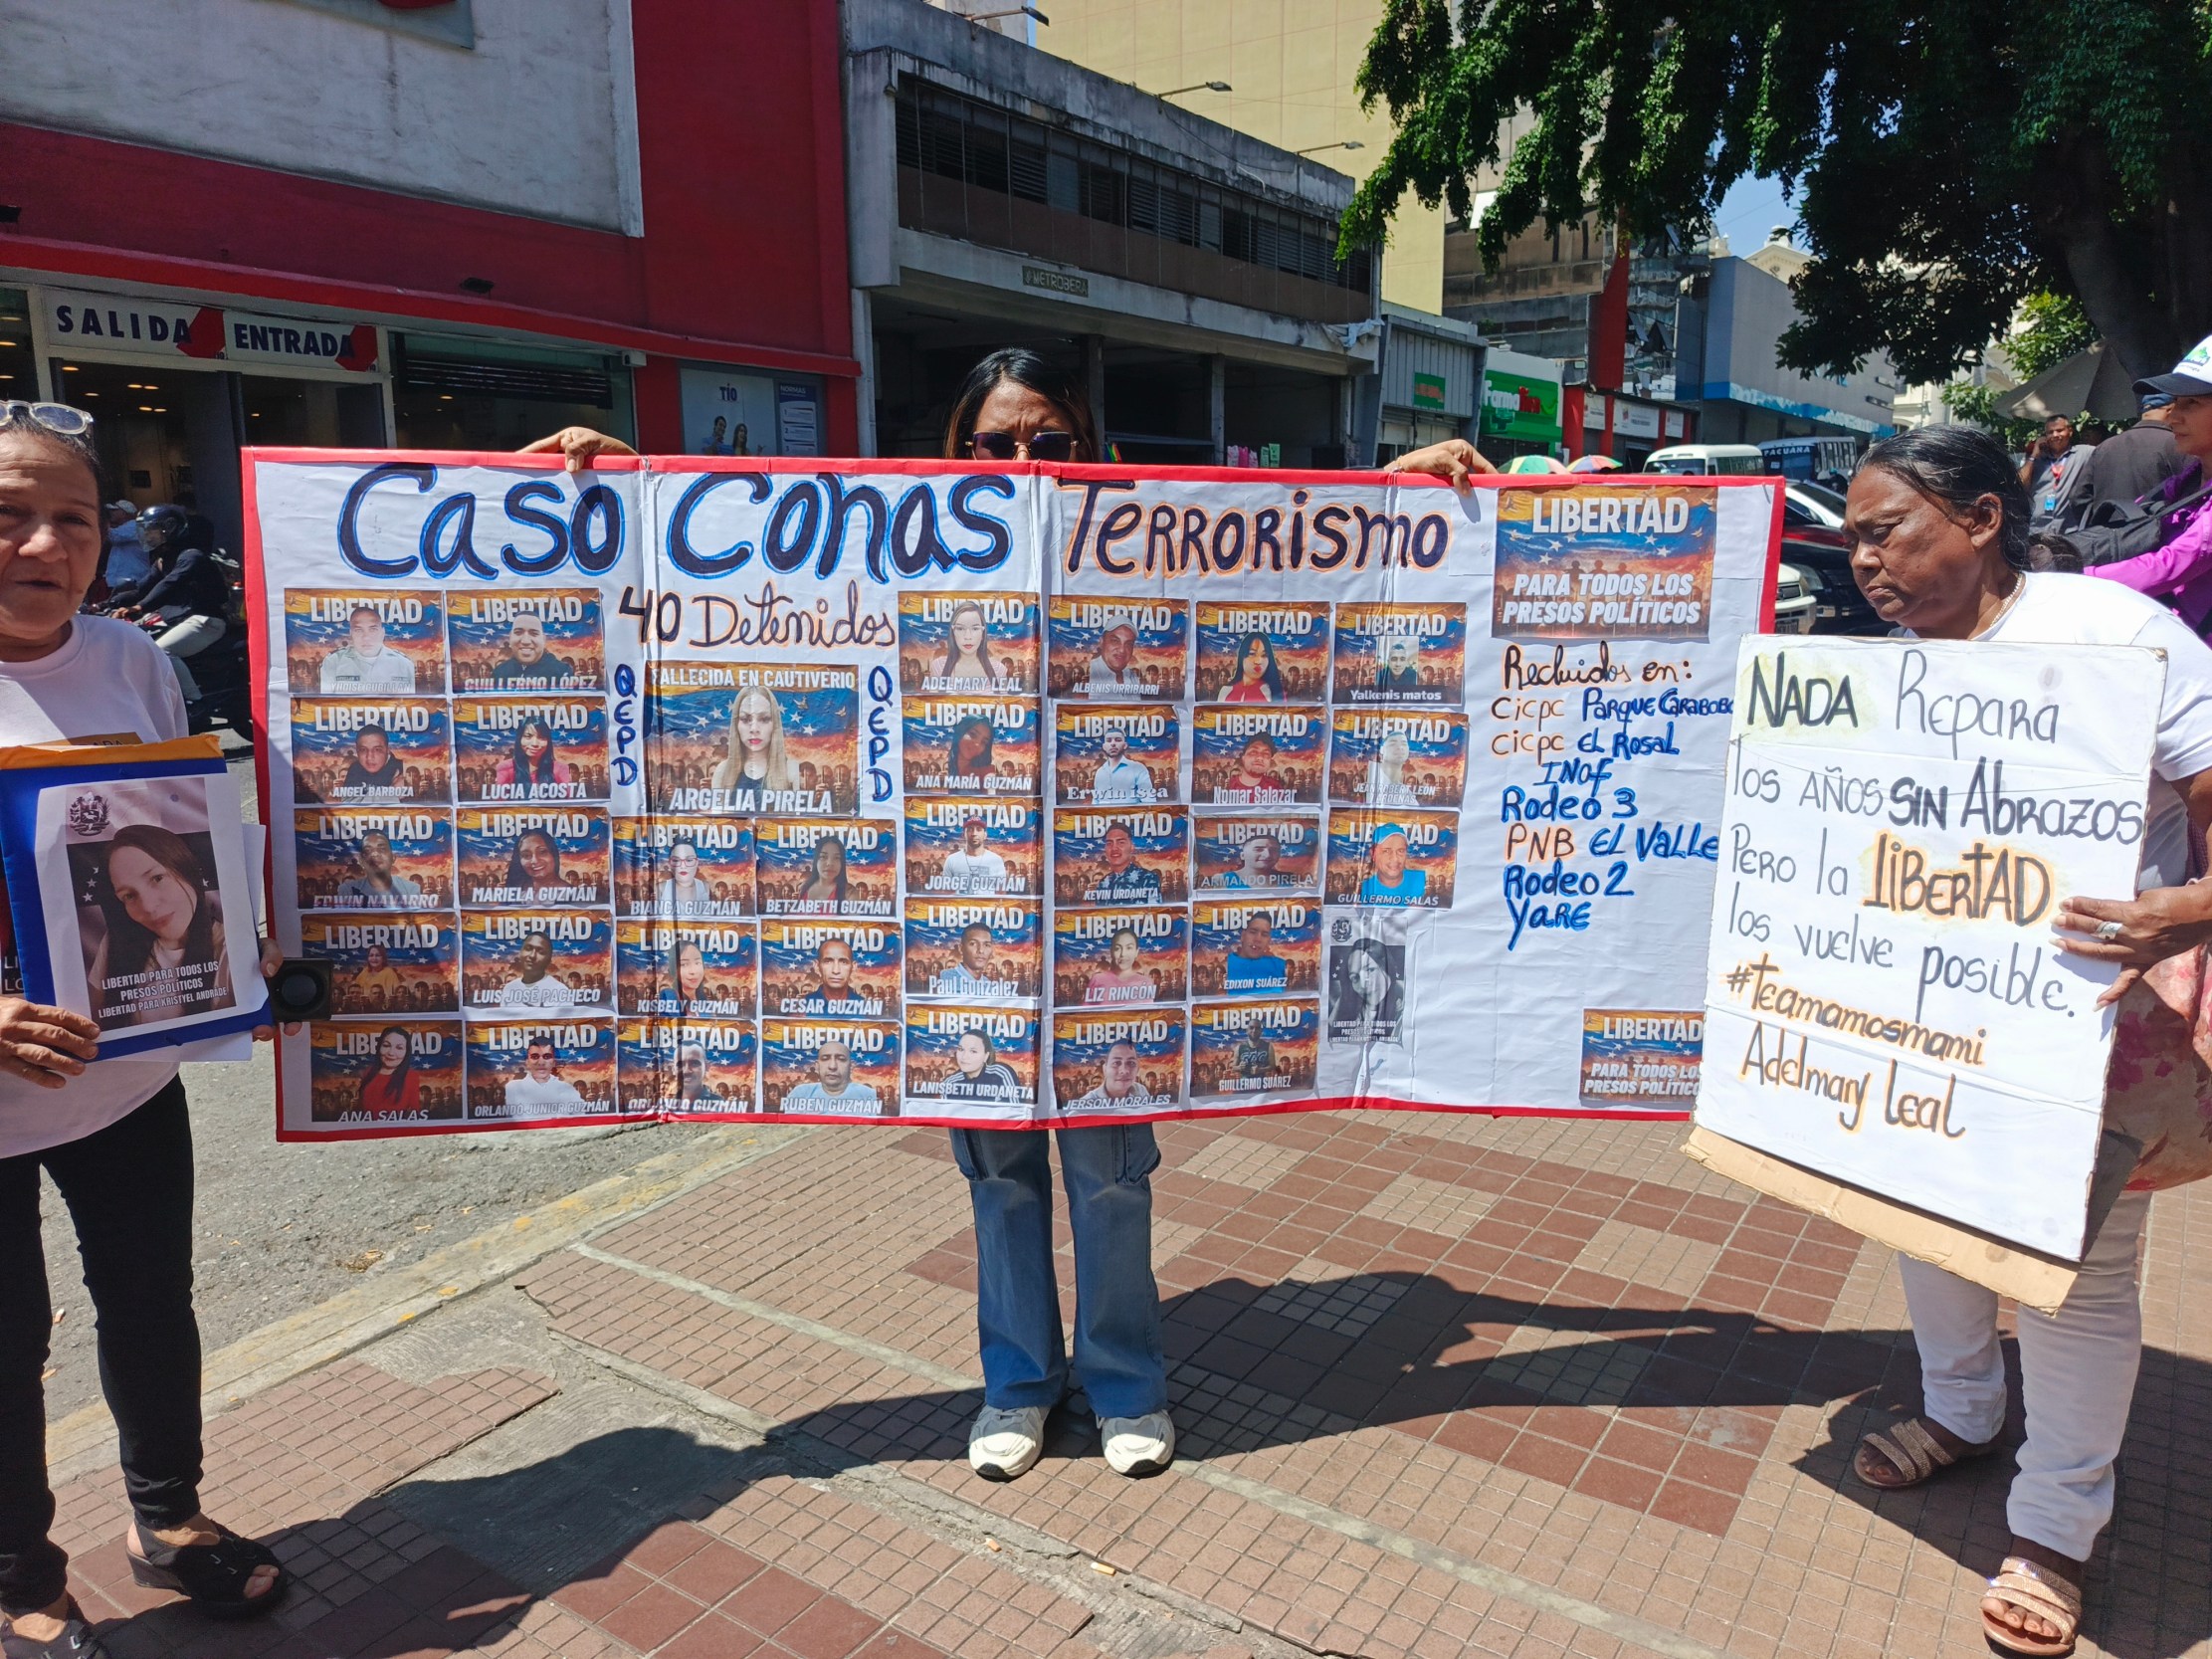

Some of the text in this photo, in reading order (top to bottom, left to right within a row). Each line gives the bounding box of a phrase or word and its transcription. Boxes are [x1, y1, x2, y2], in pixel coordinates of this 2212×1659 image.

[56, 305, 192, 345] SALIDA
[234, 323, 355, 359] ENTRADA
[336, 464, 1017, 584] Caso Conas
[1532, 497, 1689, 533] LIBERTAD
[1513, 573, 1695, 596] PARA TODOS LOS
[618, 579, 897, 648] 40 Detenidos
[1503, 594, 1702, 625] PRESOS POLÍTICOS
[1217, 610, 1312, 635] LIBERTAD
[464, 672, 598, 691] GUILLERMO LÓPEZ
[651, 668, 856, 690] FALLECIDA EN CAUTIVERIO
[921, 676, 1023, 693] ADELMARY LEAL
[1349, 689, 1442, 702] Yalkenis matos
[1747, 652, 1859, 728] NADA
[315, 706, 429, 732] LIBERTAD
[1074, 715, 1165, 738] LIBERTAD
[1215, 714, 1307, 737] LIBERTAD
[1729, 733, 1781, 804] los
[482, 781, 589, 800] LUCIA ACOSTA
[915, 773, 1032, 790] ANA MARÍA GUZMÁN
[332, 785, 414, 798] ANGEL BARBOZA
[669, 787, 833, 814] ARGELIA PIRELA
[1213, 785, 1298, 804] Nomar Salazar
[1501, 784, 1638, 823] Rodeo 3
[1507, 823, 1574, 862] PNB
[1816, 828, 1849, 897] la
[924, 873, 1025, 892] JORGE GUZMÁN
[1201, 875, 1313, 887] ARMANDO PIRELA
[1504, 858, 1635, 899] Rodeo 2
[472, 886, 597, 903] MARIELA GUZMÁN
[1084, 890, 1111, 901] KEVIN
[1337, 893, 1439, 906] GUILLERMO SALAS
[630, 899, 740, 916] BIANCA GUZMÁN
[765, 899, 892, 915] BETZABETH GUZMÁN
[1728, 882, 1771, 942] los
[928, 905, 1024, 931] LIBERTAD
[325, 925, 439, 949] LIBERTAD
[101, 960, 220, 990] LIBERTAD PARA TODOS LOS
[1223, 975, 1288, 990] EDIXON SUÁREZ
[120, 976, 204, 1002] PRESOS POLÍTICOS
[928, 974, 1019, 996] Paul Gonzalez
[1085, 983, 1156, 1002] LIZ RINCÓN
[473, 986, 601, 1004] LUIS JOSÉ PACHECO
[98, 1006, 137, 1019] LIBERTAD
[137, 1000, 160, 1013] PARA
[637, 998, 739, 1014] KISBELY GUZMÁN
[780, 997, 883, 1015] CESAR GUZMÁN
[928, 1011, 1026, 1038] LIBERTAD
[1076, 1019, 1168, 1045] LIBERTAD
[1603, 1017, 1704, 1042] LIBERTAD
[1591, 1063, 1628, 1077] PARA
[1633, 1063, 1677, 1079] TODOS
[913, 1081, 1034, 1099] LANISBETH URDANETA
[1219, 1075, 1292, 1092] GUILLERMO SUÁREZ
[1583, 1080, 1638, 1094] PRESOS
[475, 1104, 519, 1117] ORLANDO
[566, 1100, 610, 1113] GUZMÁN
[693, 1097, 749, 1113] GUZMÁN
[779, 1096, 883, 1114] RUBEN GUZMÁN
[1063, 1094, 1171, 1110] JERSON MORALES
[338, 1109, 429, 1123] ANA SALAS
